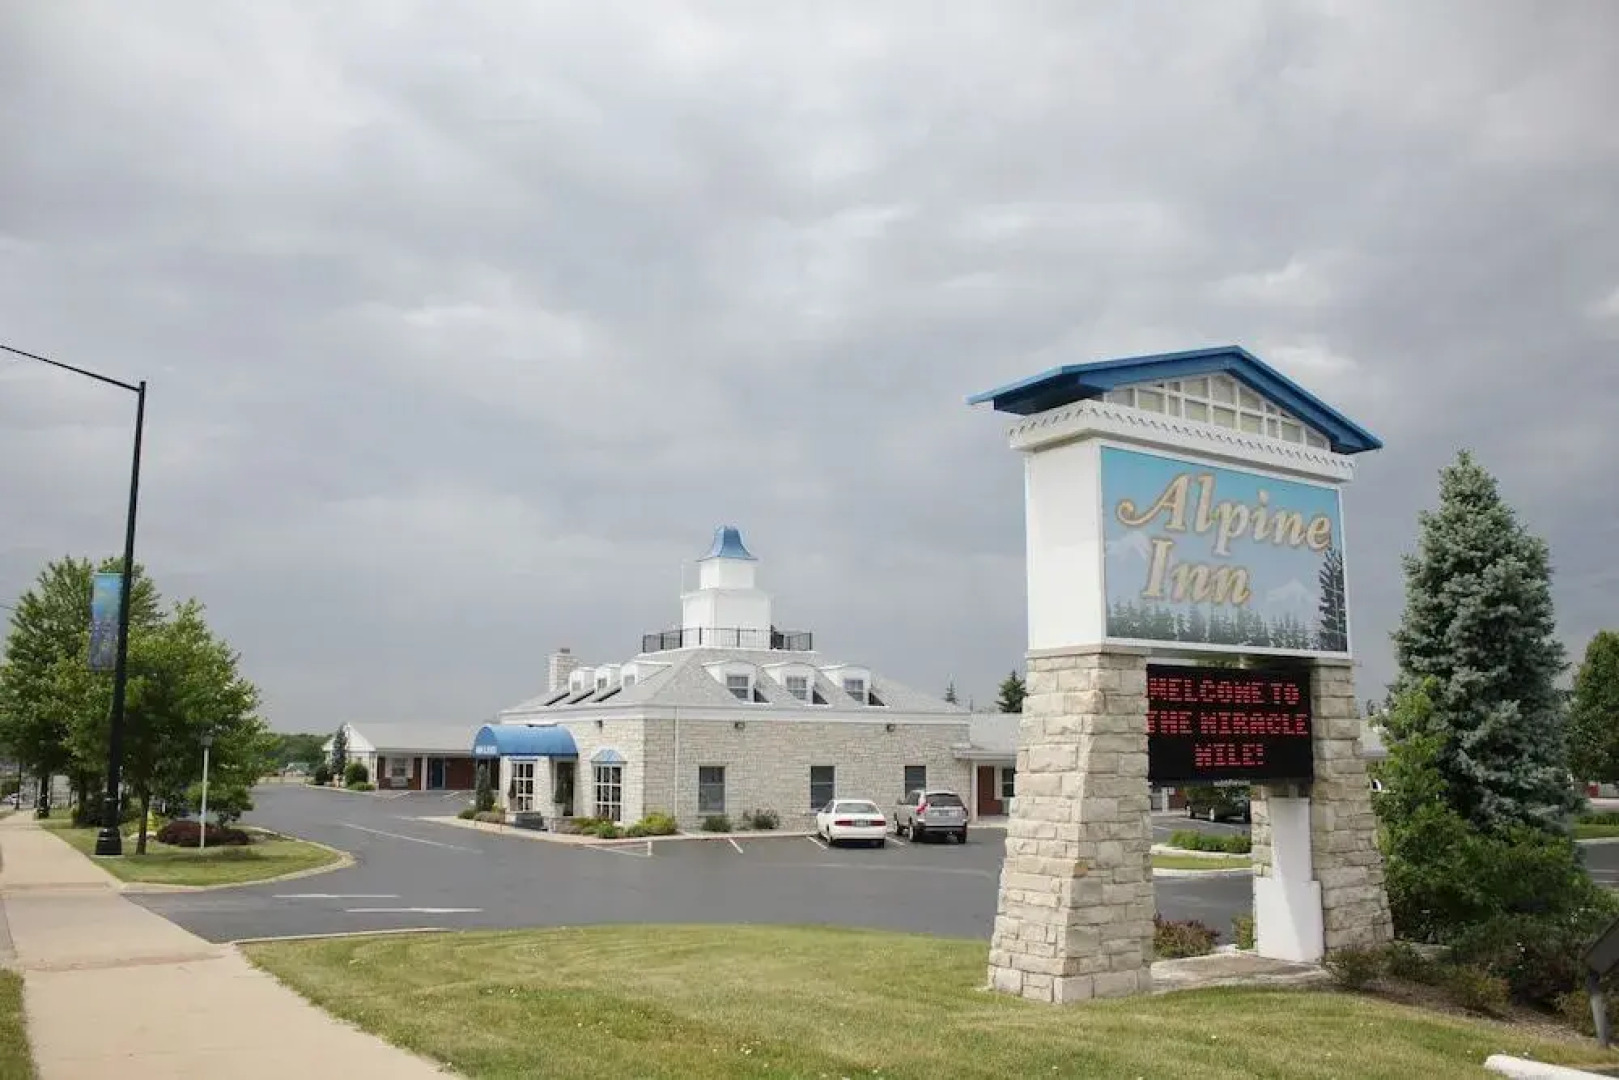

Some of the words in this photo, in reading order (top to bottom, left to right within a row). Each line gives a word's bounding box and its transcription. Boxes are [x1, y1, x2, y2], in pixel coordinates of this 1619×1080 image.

[1115, 470, 1332, 557] Alpine
[1140, 537, 1252, 606] Inn
[1149, 677, 1266, 704] WELCOME
[1270, 682, 1301, 705] TO
[1147, 710, 1193, 735] THE
[1200, 711, 1309, 735] MIRACLE
